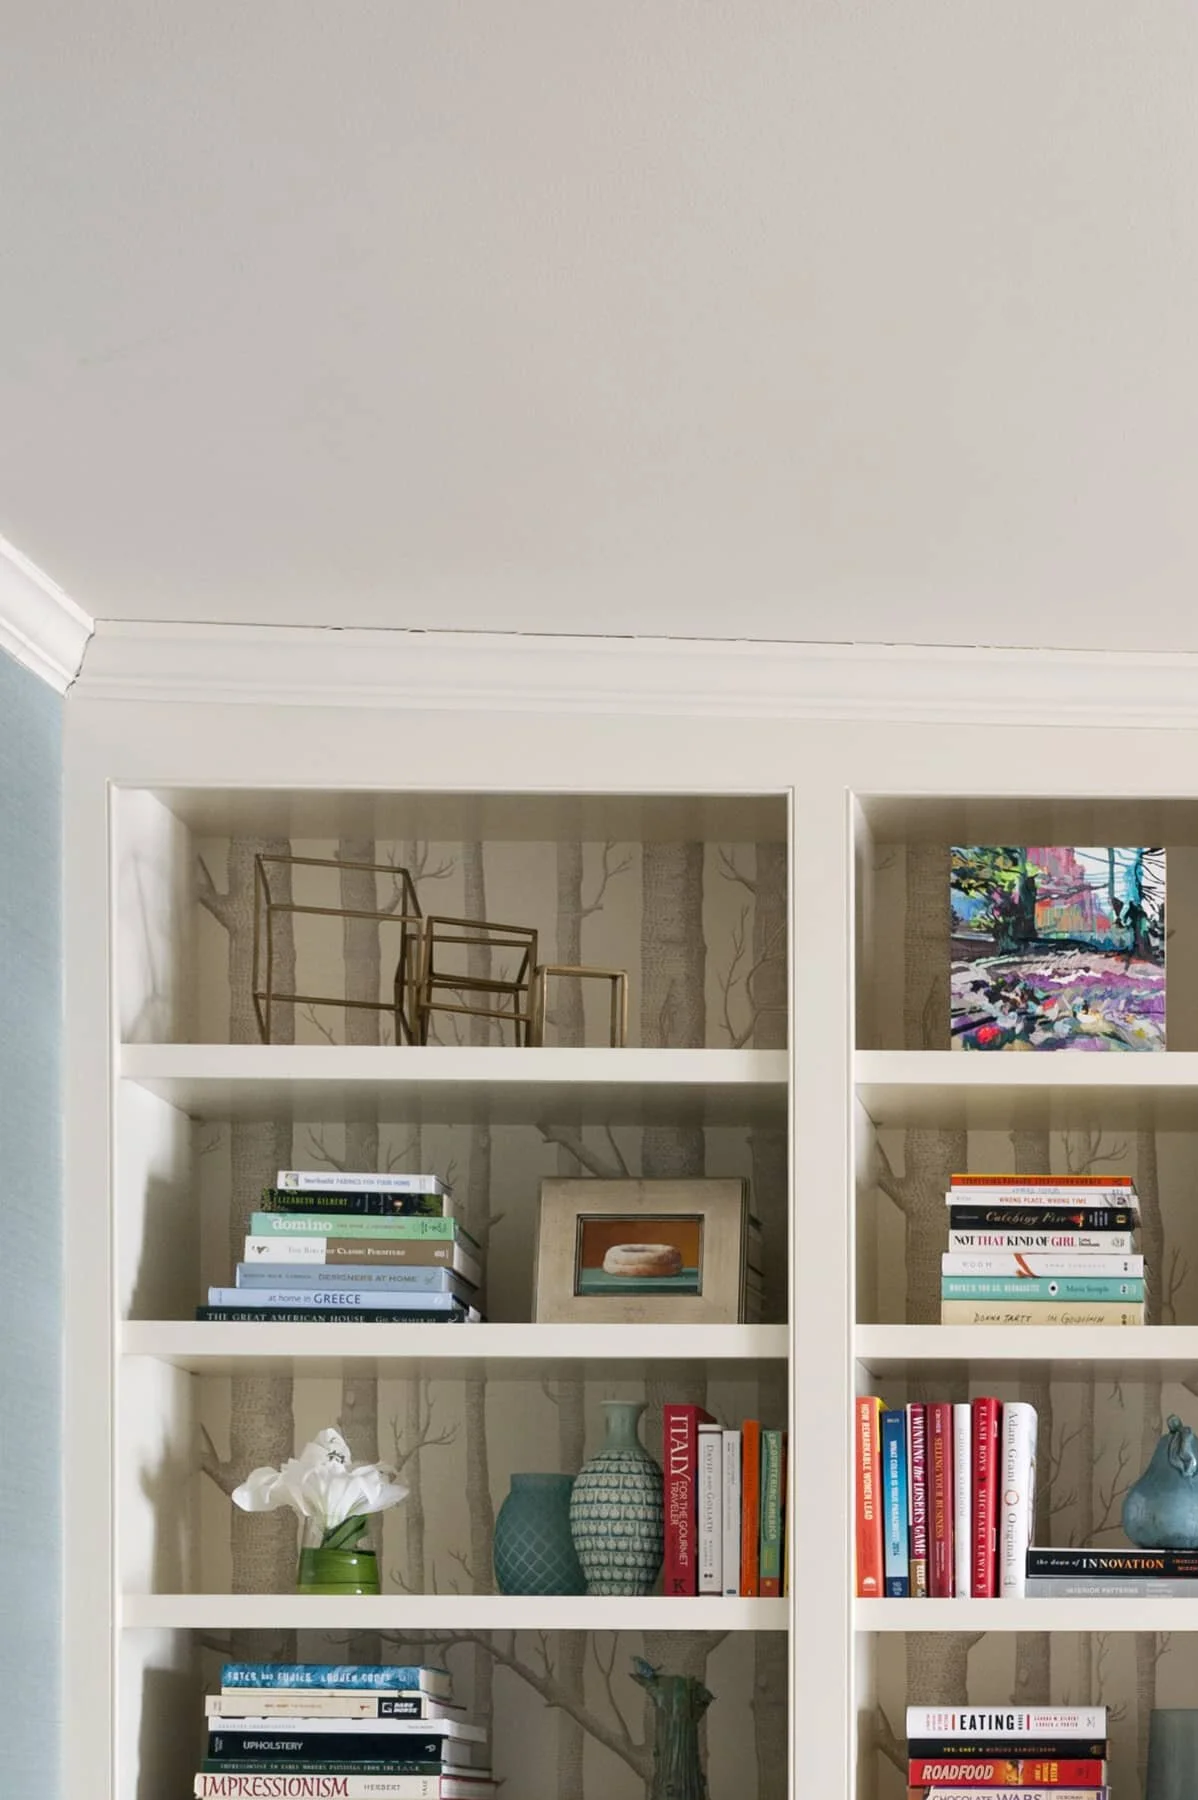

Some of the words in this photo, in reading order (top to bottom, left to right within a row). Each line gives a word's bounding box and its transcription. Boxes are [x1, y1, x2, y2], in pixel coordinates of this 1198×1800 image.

[272, 1217, 332, 1231] domino
[986, 1210, 1037, 1224] Catching
[954, 1235, 978, 1246] NOT
[978, 1236, 1004, 1246] THAT
[1007, 1236, 1034, 1246] KIND
[1036, 1236, 1050, 1246] OF
[1051, 1236, 1074, 1246] GIRL
[318, 1273, 373, 1282] DESIGNERS
[375, 1274, 388, 1282] AT
[389, 1274, 417, 1283] HOME
[278, 1294, 302, 1302] home
[302, 1294, 312, 1303] in
[313, 1294, 361, 1304] GREECE
[207, 1312, 228, 1322] THE
[232, 1312, 268, 1322] GREAT
[271, 1313, 326, 1322] AMERICAN
[330, 1314, 365, 1322] HOUSE
[979, 1406, 987, 1440] FLASH
[1008, 1410, 1018, 1444] Adam
[670, 1416, 692, 1482] ITALY
[862, 1422, 872, 1470] REMARKABLE
[912, 1416, 924, 1462] WINNING
[706, 1444, 715, 1473] DAVID
[934, 1438, 942, 1472] SELLING
[979, 1445, 987, 1472] BOYS
[1008, 1448, 1018, 1482] Grant
[864, 1472, 872, 1500] WOMEN
[914, 1464, 924, 1480] the
[935, 1474, 944, 1497] YOUR
[670, 1482, 680, 1526] TRAVELER
[679, 1482, 688, 1500] FOR
[914, 1482, 926, 1524] LOSER'S
[679, 1500, 688, 1518] THE
[706, 1494, 715, 1533] GOLIATH
[768, 1502, 777, 1540] AMERICA
[864, 1500, 873, 1520] LEAD
[936, 1499, 944, 1538] BUSINESS
[978, 1488, 986, 1540] MICHAEL
[679, 1519, 688, 1567] GOURMET
[914, 1526, 926, 1555] GAME
[1005, 1513, 1018, 1566] Originals
[978, 1544, 986, 1578] LEWIS
[1072, 1558, 1080, 1566] of
[1082, 1558, 1164, 1568] INNOVATION
[960, 1714, 1014, 1730] EATING
[243, 1741, 303, 1750] UPHOLSTERY
[922, 1765, 994, 1779] ROADFOOD
[202, 1776, 349, 1798] IMPRESSIONISM
